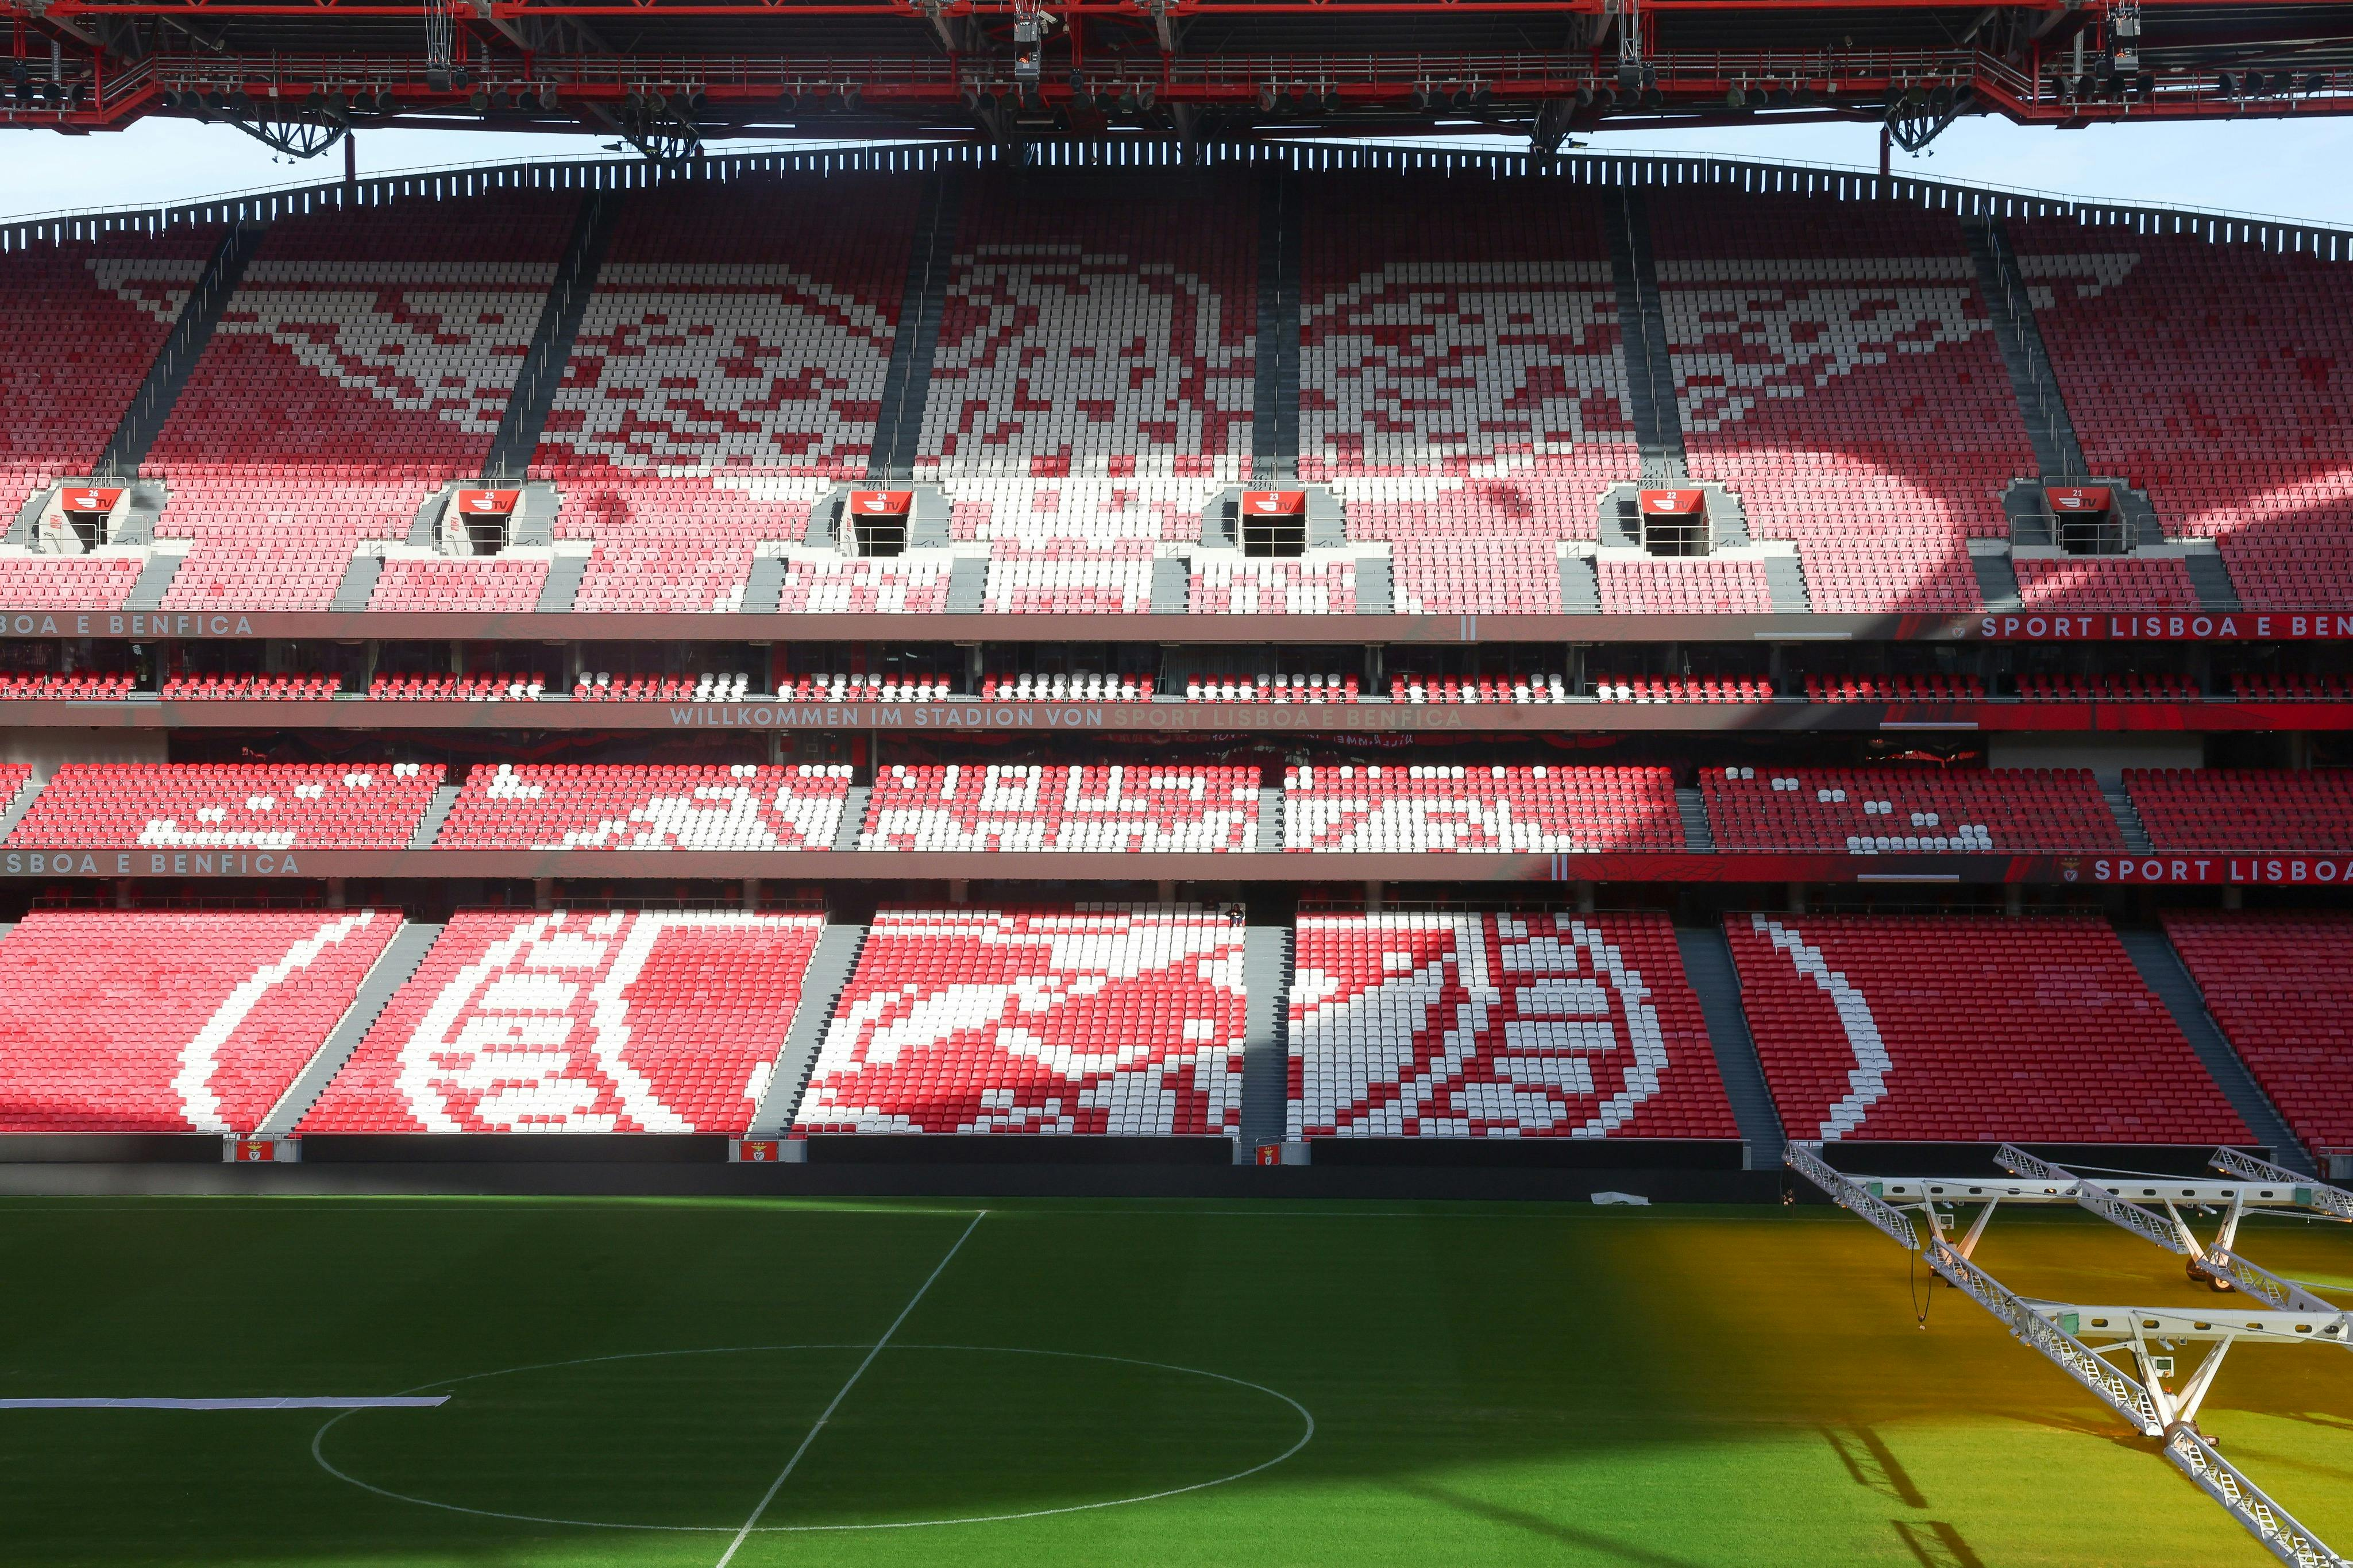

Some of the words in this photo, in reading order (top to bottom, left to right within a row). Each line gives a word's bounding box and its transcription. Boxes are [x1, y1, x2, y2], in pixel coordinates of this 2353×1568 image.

[77, 616, 89, 634] E
[110, 616, 252, 634] BENFICA
[1982, 617, 2092, 636] SPORT
[2112, 617, 2238, 636] LISBOA
[2258, 617, 2270, 635] E
[2292, 616, 2353, 635] BEN
[670, 708, 858, 725] WILLKOMMEN
[871, 708, 902, 725] IM
[915, 708, 1033, 725] STADION
[1046, 708, 1101, 725] VON
[1115, 709, 1201, 727] SPORT
[1213, 709, 1310, 727] LISBOA
[1322, 709, 1333, 727] E
[1347, 709, 1462, 727] BENFICA
[118, 854, 130, 873] E
[151, 854, 299, 874] BENFICA
[2095, 860, 2210, 880] SPORT
